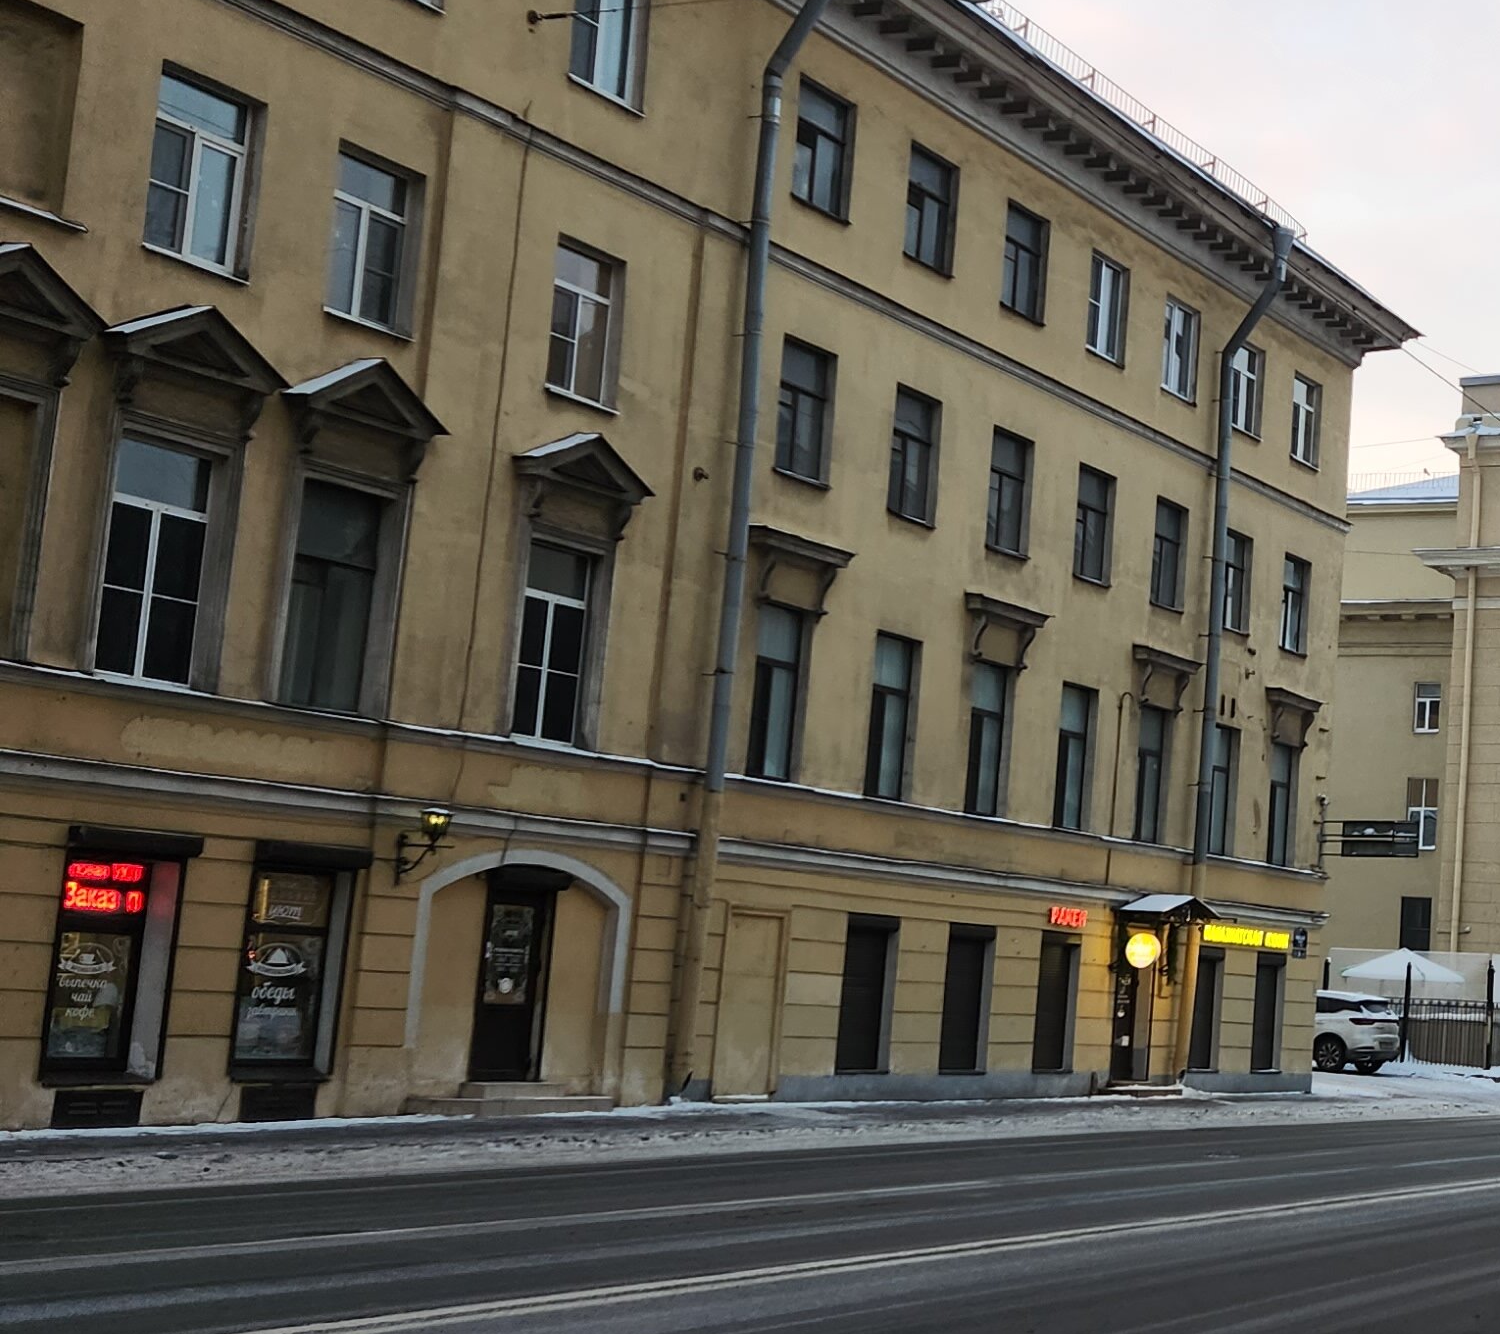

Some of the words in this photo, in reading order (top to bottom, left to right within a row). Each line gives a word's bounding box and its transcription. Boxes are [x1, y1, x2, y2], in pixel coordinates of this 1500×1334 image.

[64, 880, 121, 912] Заказ
[71, 990, 93, 1003] чай
[251, 981, 296, 1006] обеды
[65, 1004, 95, 1021] кофе
